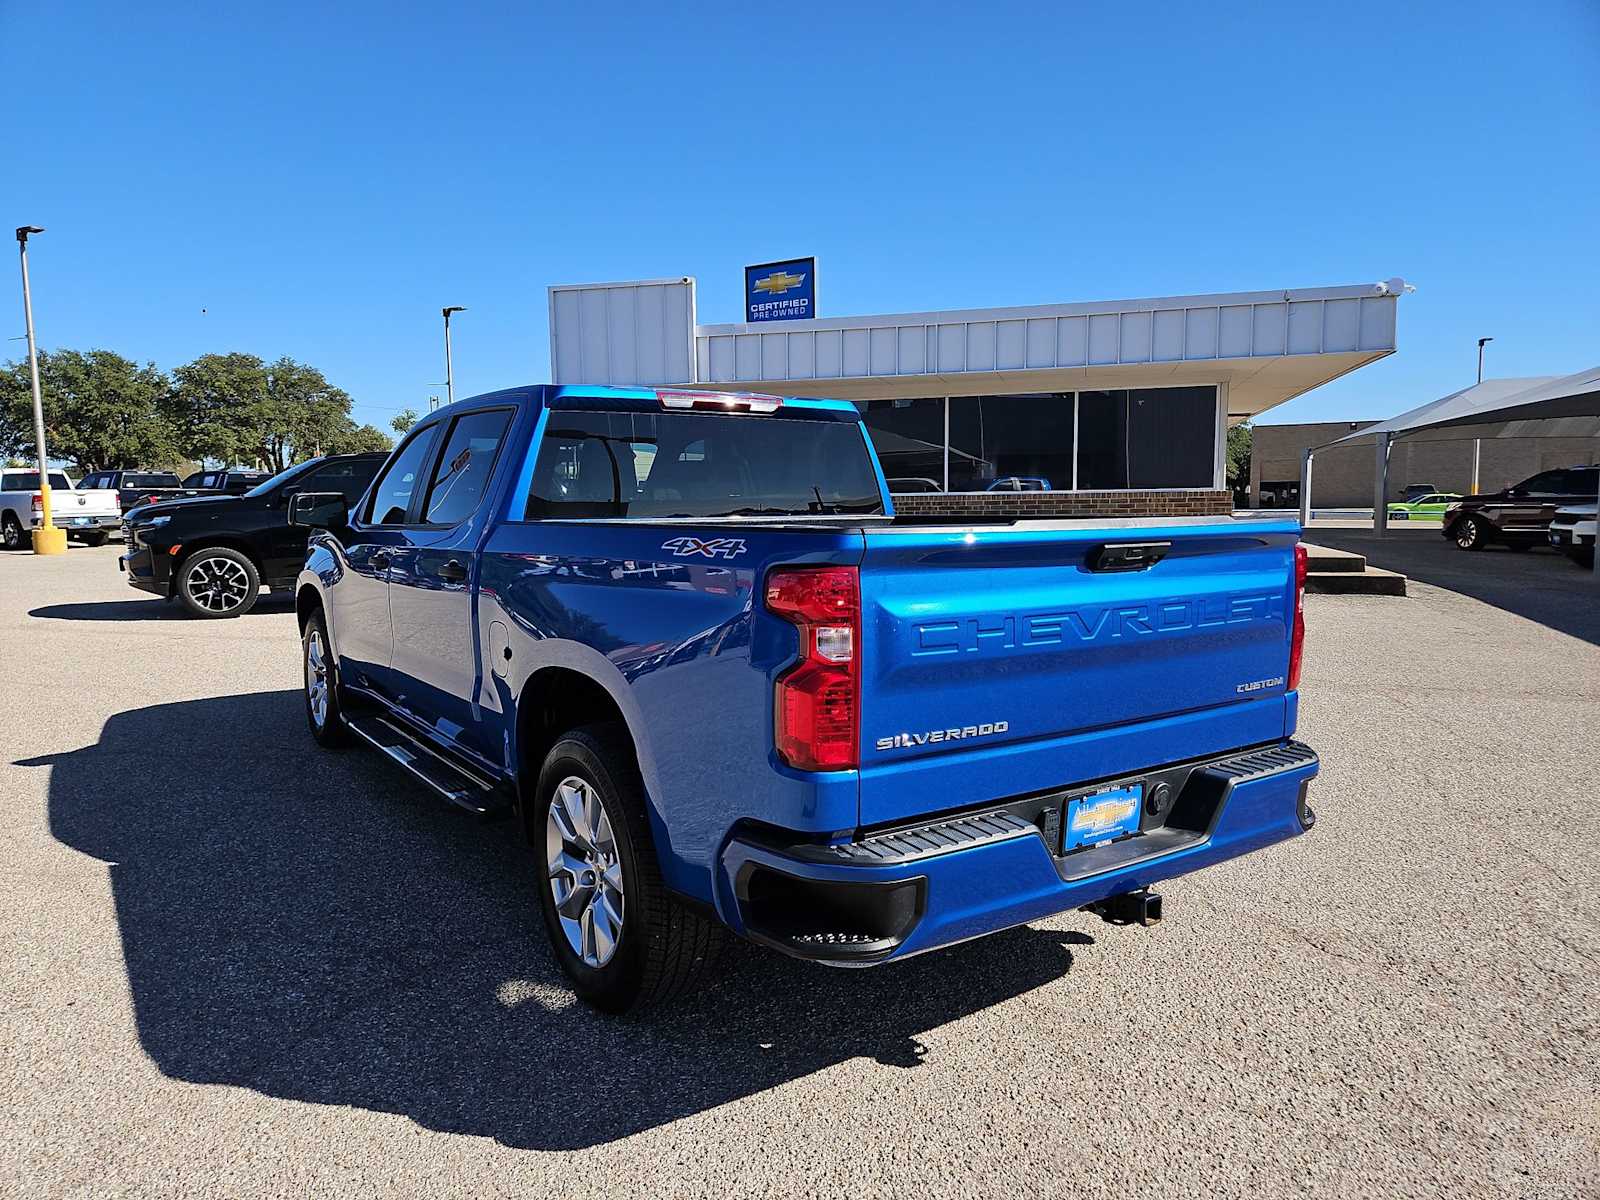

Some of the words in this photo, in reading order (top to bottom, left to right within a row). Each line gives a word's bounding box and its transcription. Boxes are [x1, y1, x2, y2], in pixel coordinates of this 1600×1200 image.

[750, 298, 808, 312] CERTIFIED
[753, 306, 806, 319] PRE-OWNED
[911, 594, 1283, 656] CHEVROLET
[1236, 677, 1283, 693] CUSTOM
[876, 720, 1009, 750] SILVERADO
